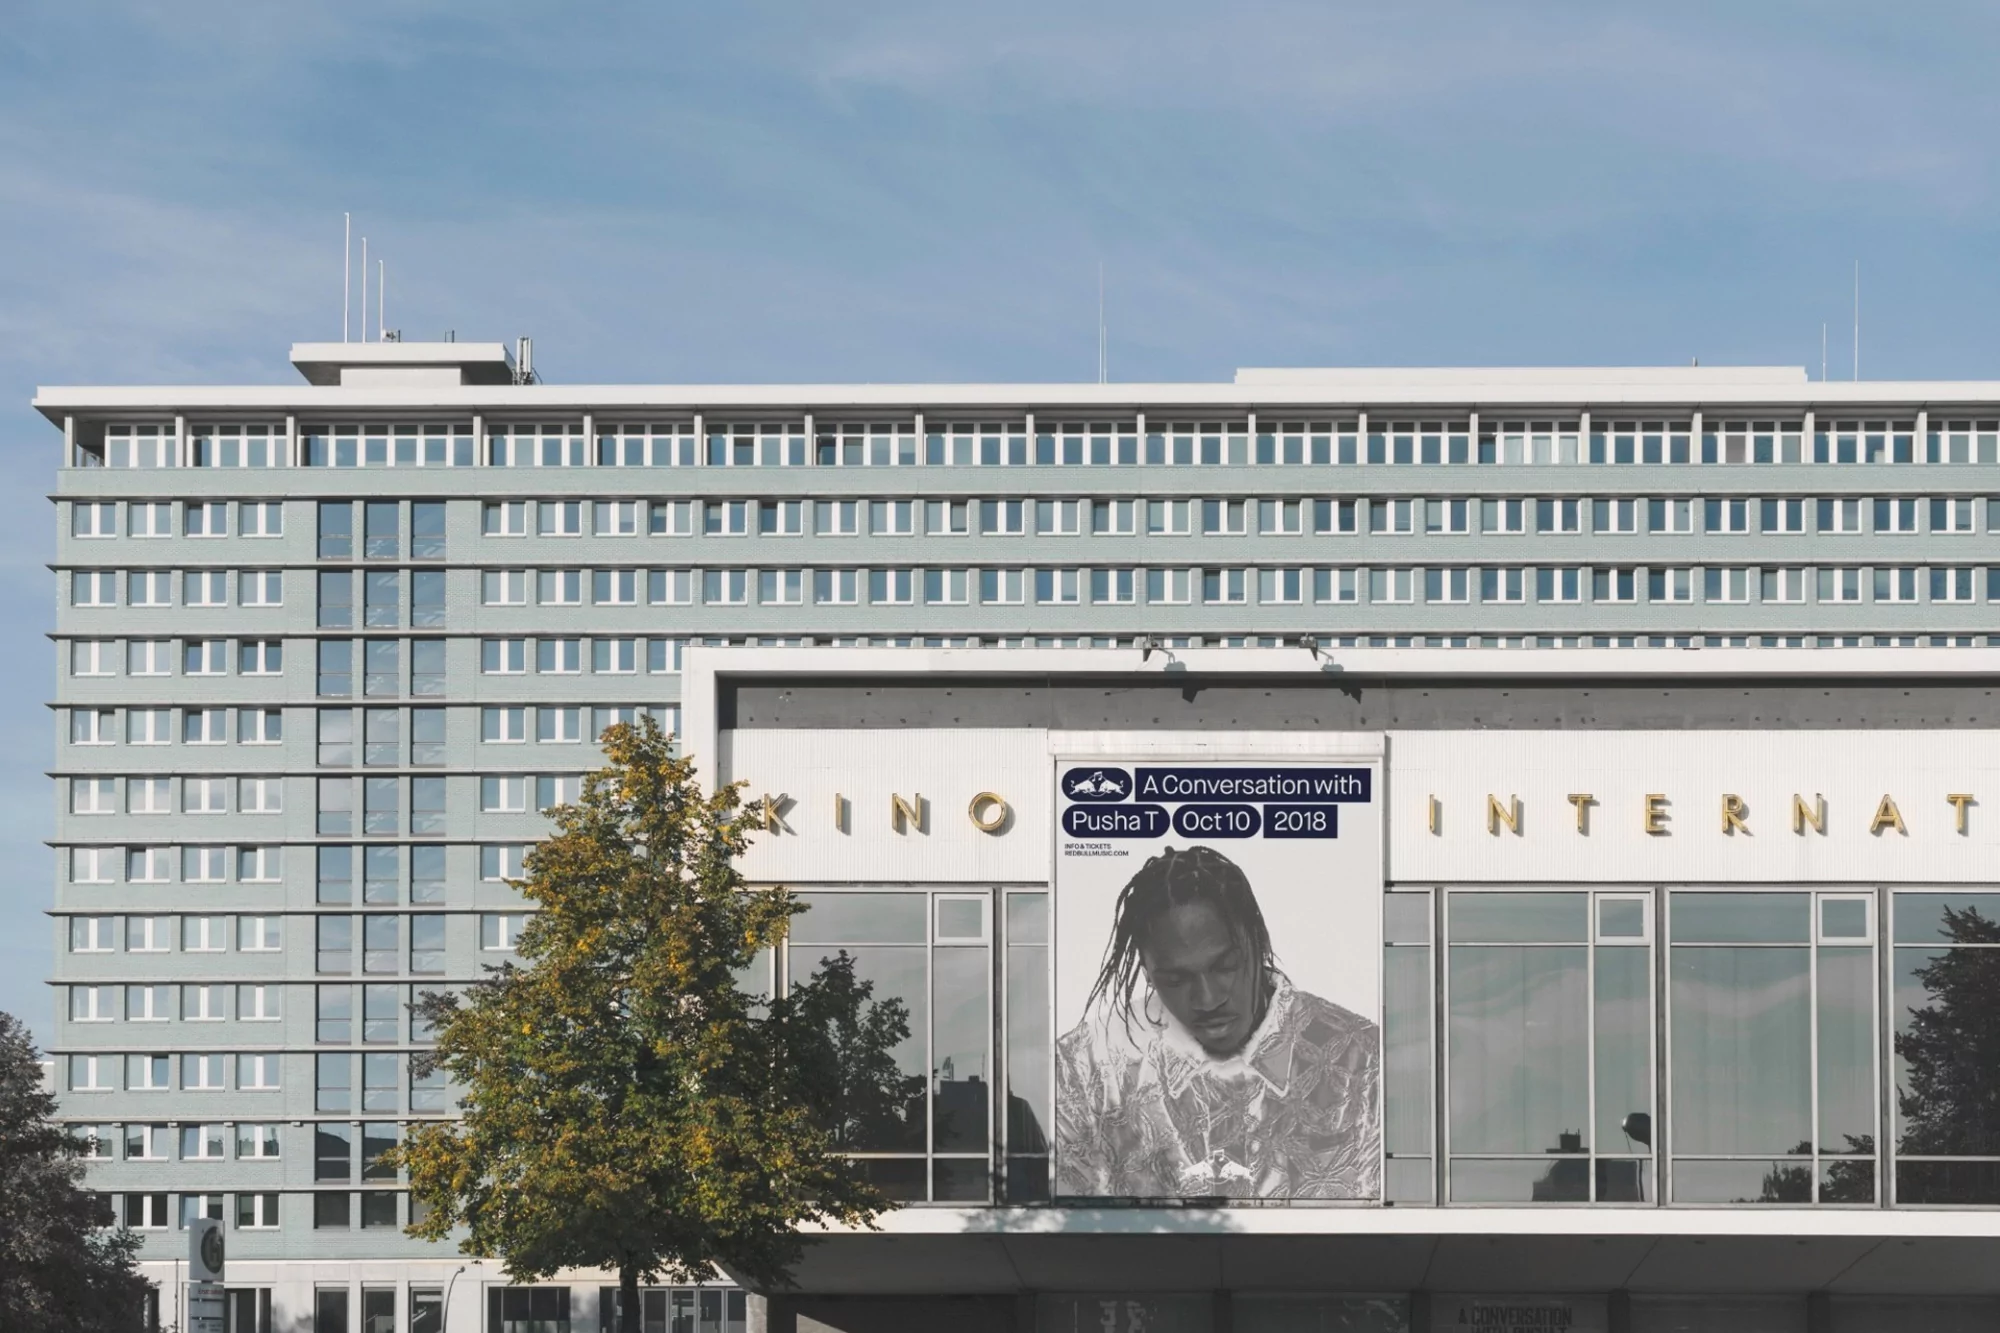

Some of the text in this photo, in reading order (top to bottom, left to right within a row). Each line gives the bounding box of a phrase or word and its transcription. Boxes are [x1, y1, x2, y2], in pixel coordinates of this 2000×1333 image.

[1143, 774, 1362, 795] A Conversation with
[763, 791, 1974, 833] KINO INTERNAT
[1072, 810, 1327, 831] Pusha T Oct 10 2018
[1471, 1307, 1573, 1325] CONVERSATION
